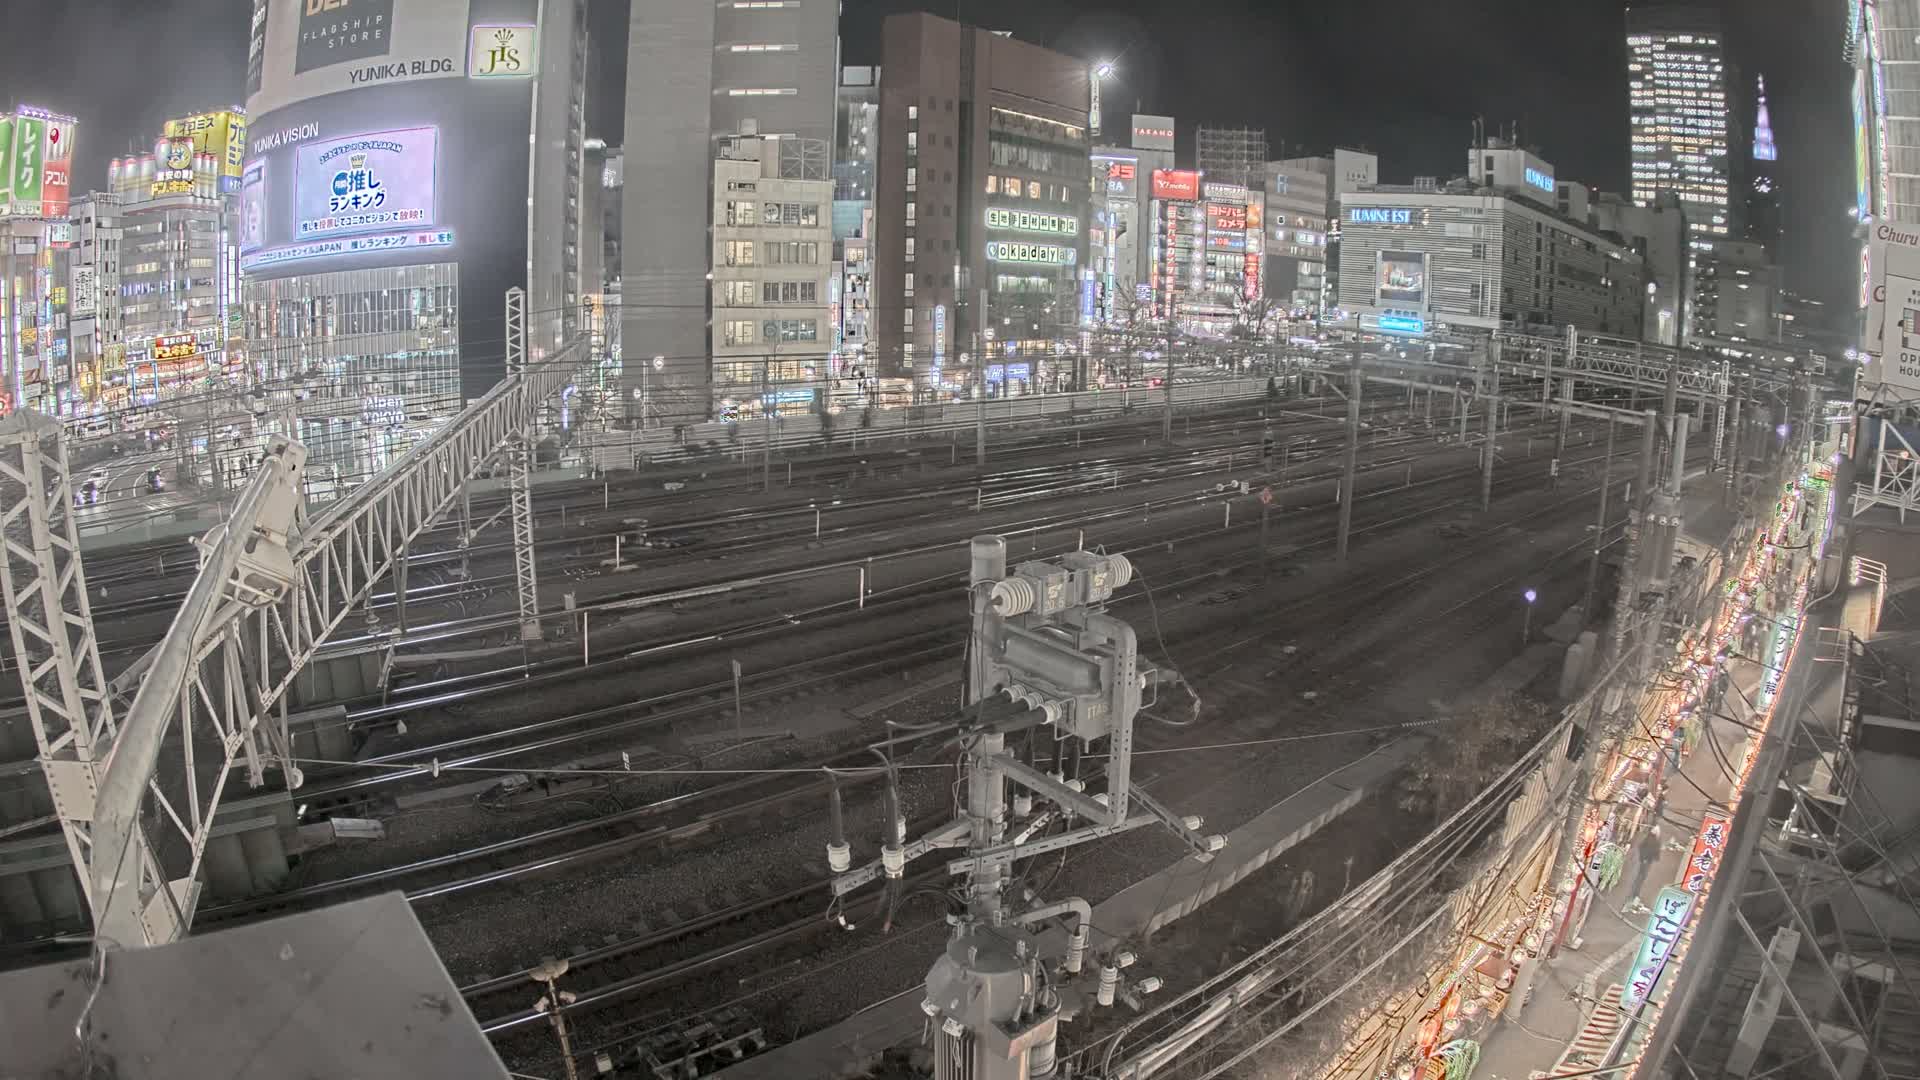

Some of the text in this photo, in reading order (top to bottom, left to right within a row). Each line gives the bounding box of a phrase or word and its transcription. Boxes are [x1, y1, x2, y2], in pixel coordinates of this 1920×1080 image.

[303, 15, 383, 42] FLAGSHIP
[328, 29, 382, 48] STORE
[349, 58, 455, 84] YUNIKA BLDG.
[254, 121, 319, 153] YUNIKA VISION
[20, 122, 36, 188] レイク
[45, 170, 68, 186] アコム
[330, 190, 386, 211] ランキング
[1208, 206, 1245, 218] ヨドバシ
[1352, 208, 1410, 223] LUMINE EST
[1218, 218, 1245, 229] カメラ
[1877, 225, 1919, 246] Churu
[1000, 246, 1065, 261] okadaya
